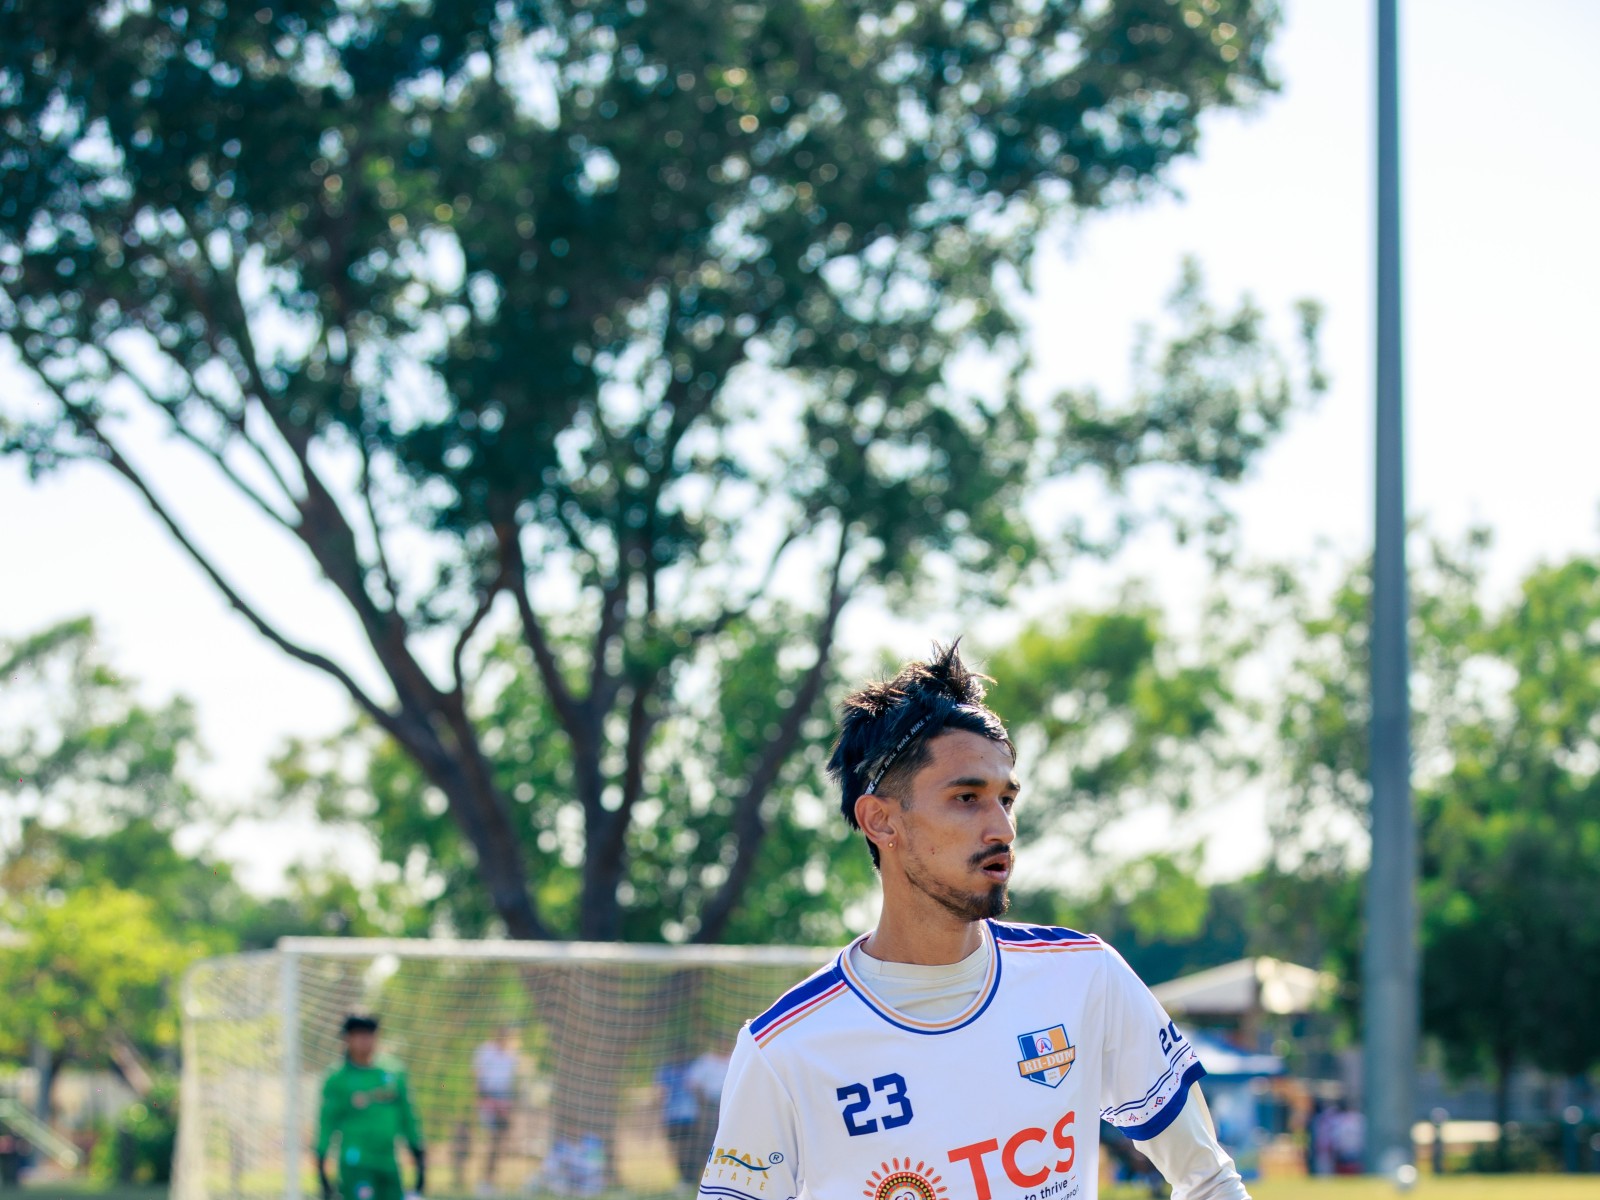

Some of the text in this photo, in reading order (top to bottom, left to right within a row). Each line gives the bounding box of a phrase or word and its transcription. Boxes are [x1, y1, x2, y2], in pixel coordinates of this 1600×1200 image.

[910, 720, 926, 735] NIKE
[1023, 1050, 1073, 1073] RII-DUM
[836, 1072, 914, 1137] 23
[1040, 1179, 1068, 1199] thrive
